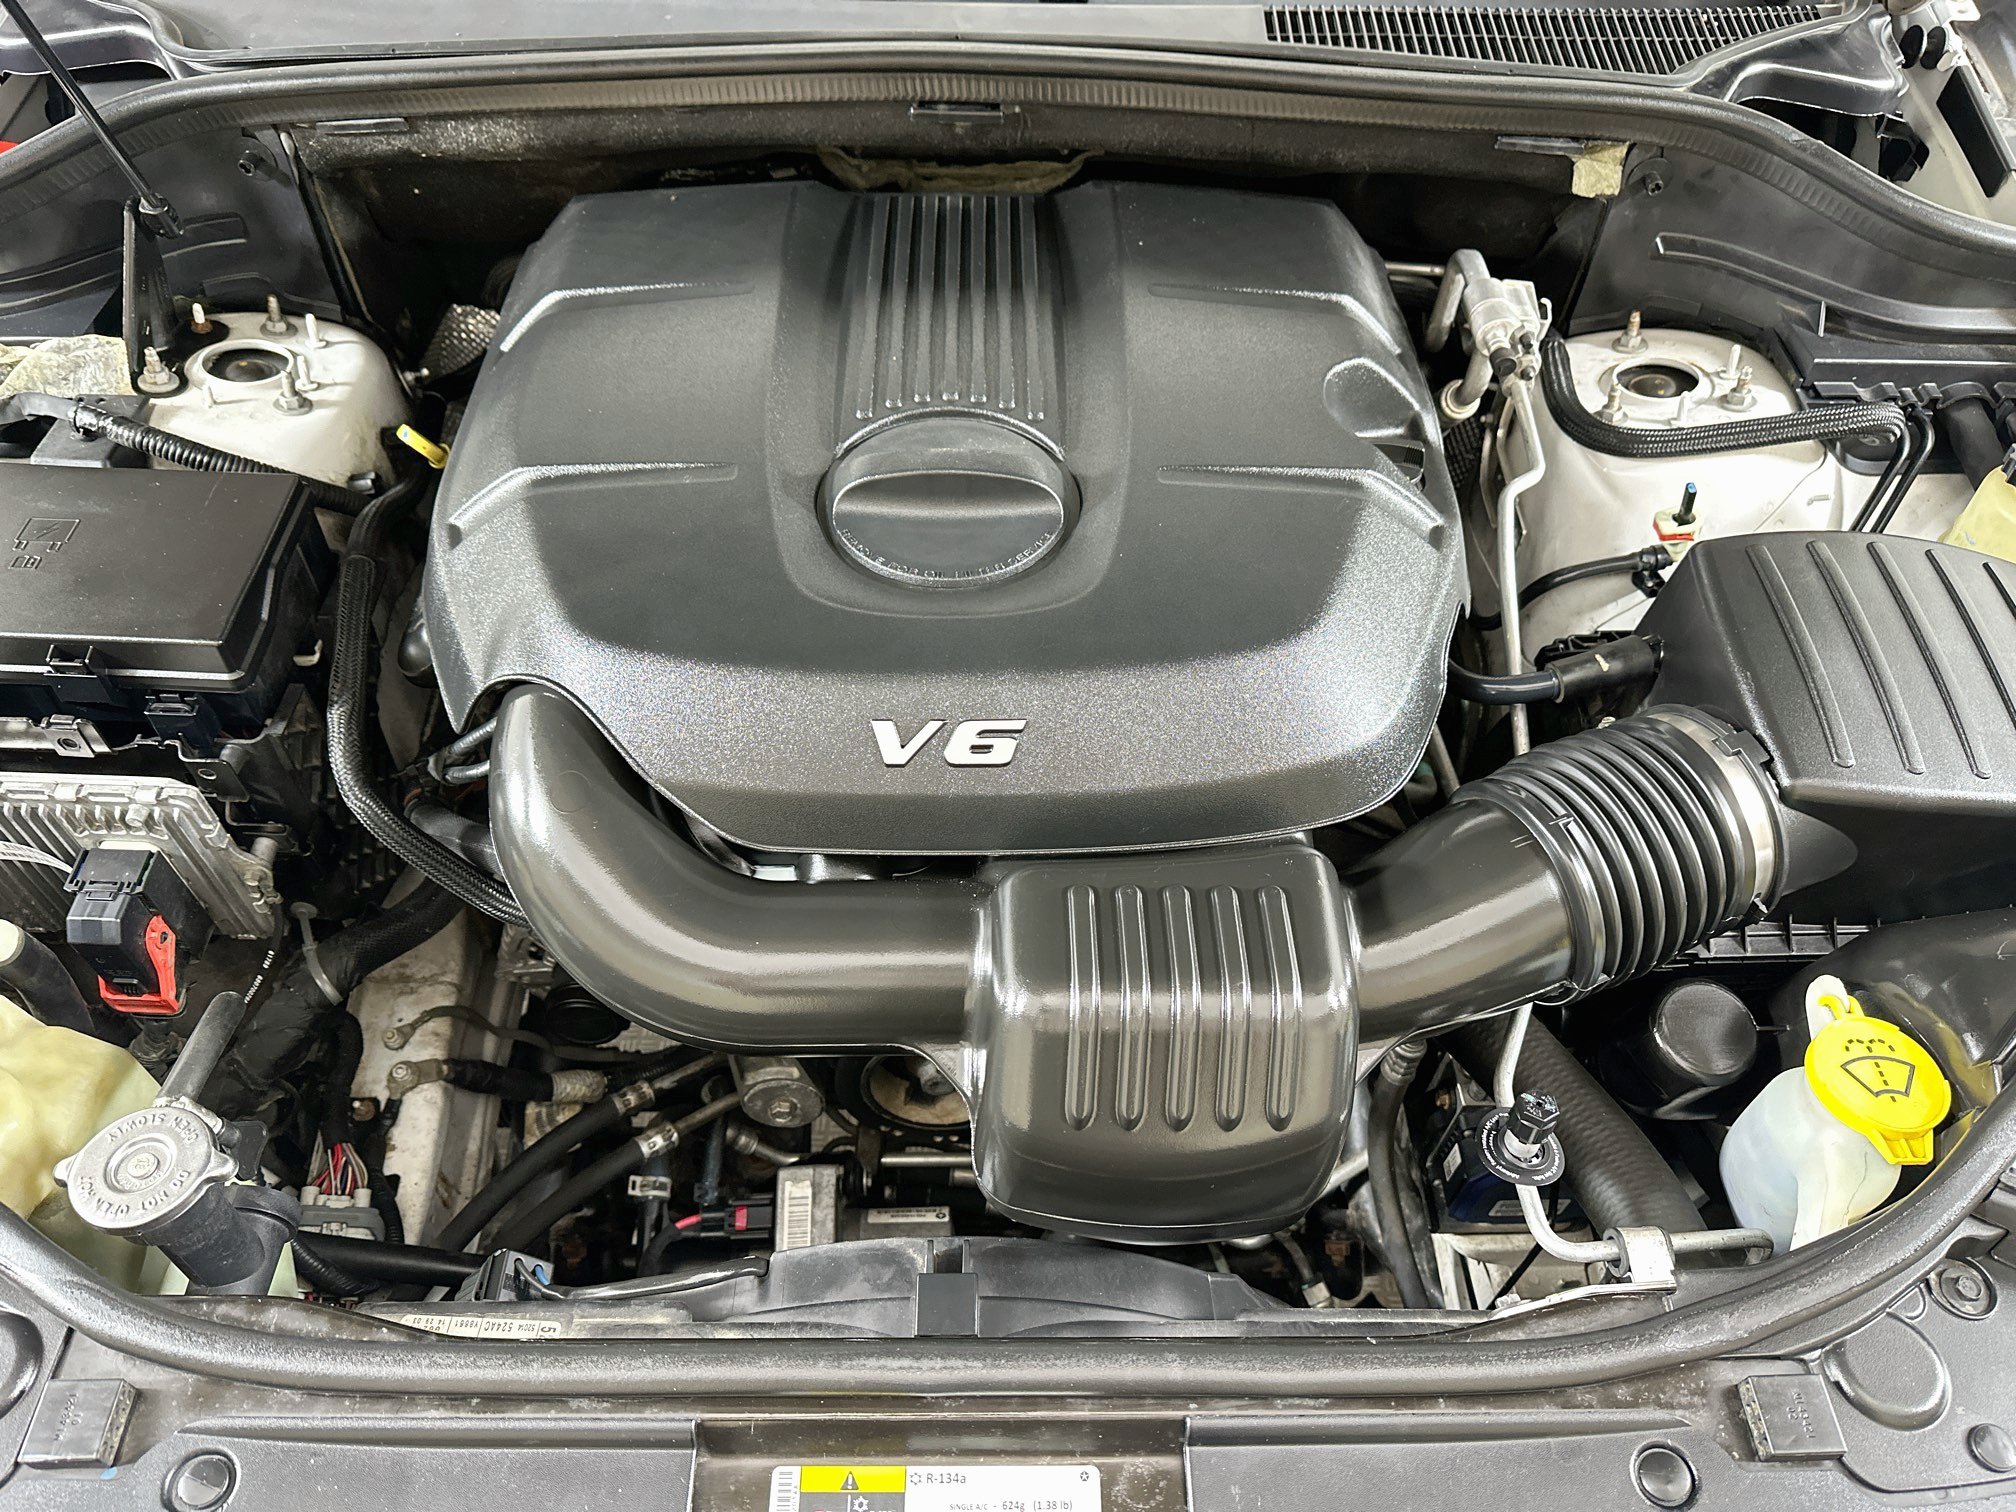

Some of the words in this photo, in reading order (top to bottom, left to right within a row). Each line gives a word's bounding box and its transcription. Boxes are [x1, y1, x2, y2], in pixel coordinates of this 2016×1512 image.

[887, 561, 919, 577] FOR
[871, 719, 1028, 768] V6
[107, 1112, 167, 1143] SLOWLY
[171, 1115, 200, 1143] OPEN
[170, 1170, 191, 1190] DO
[139, 1190, 169, 1212] NOT
[484, 1320, 514, 1332] 524AC
[926, 1472, 967, 1484] R-134a
[949, 1503, 974, 1511] SINGLE
[976, 1503, 988, 1511] A/C
[1002, 1500, 1025, 1512] 624g
[1033, 1500, 1058, 1512] (1.38
[1060, 1500, 1073, 1512] lb)
